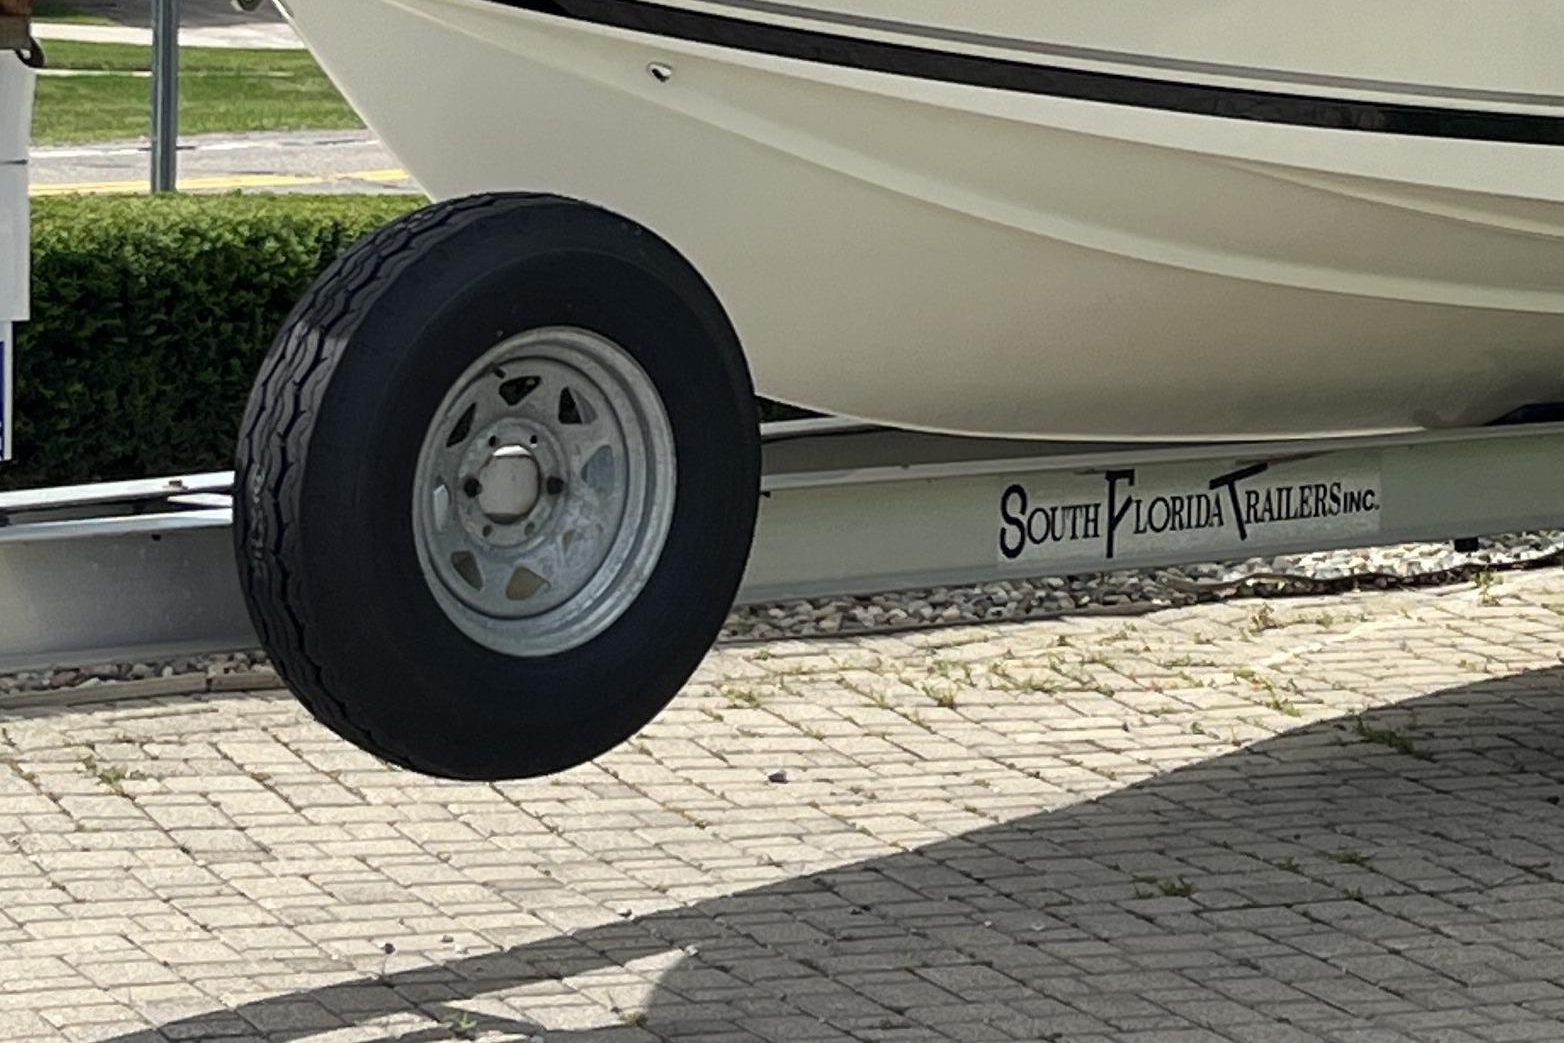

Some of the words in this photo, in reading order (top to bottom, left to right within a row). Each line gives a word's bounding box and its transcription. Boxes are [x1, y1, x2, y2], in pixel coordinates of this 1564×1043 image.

[999, 483, 1101, 559] SOUTH
[1105, 468, 1224, 559] FLORIDA
[1208, 462, 1342, 542] TRAILERS
[1343, 491, 1380, 513] INC.
